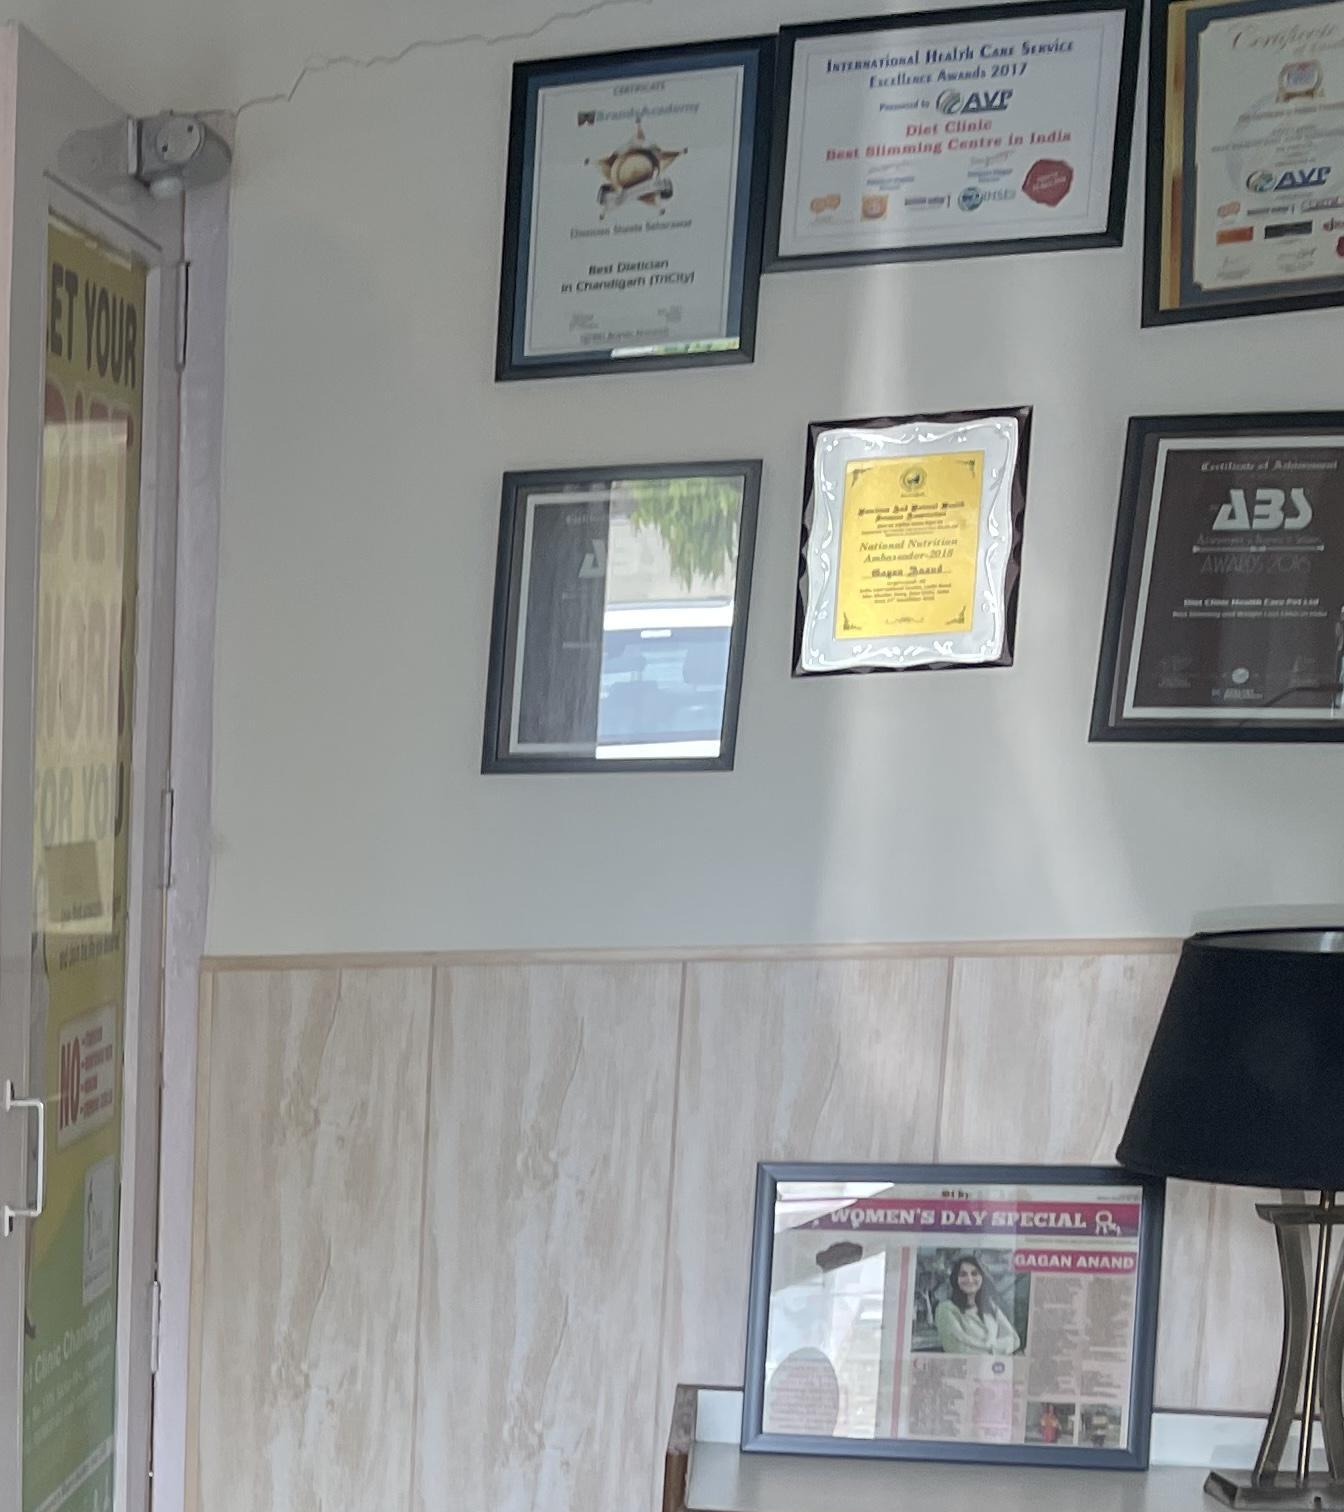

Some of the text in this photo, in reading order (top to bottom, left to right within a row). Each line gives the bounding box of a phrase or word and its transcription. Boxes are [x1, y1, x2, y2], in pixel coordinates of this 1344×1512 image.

[991, 62, 1028, 79] 2017
[960, 88, 1014, 115] AVP
[944, 119, 993, 134] Clinic
[1030, 130, 1072, 145] India
[46, 261, 139, 390] ET YOUR
[1212, 487, 1313, 531] ABS
[831, 1207, 1087, 1229] WOMEN'S DAY SPECIAL
[1014, 1253, 1135, 1270] GAGAN ANAND
